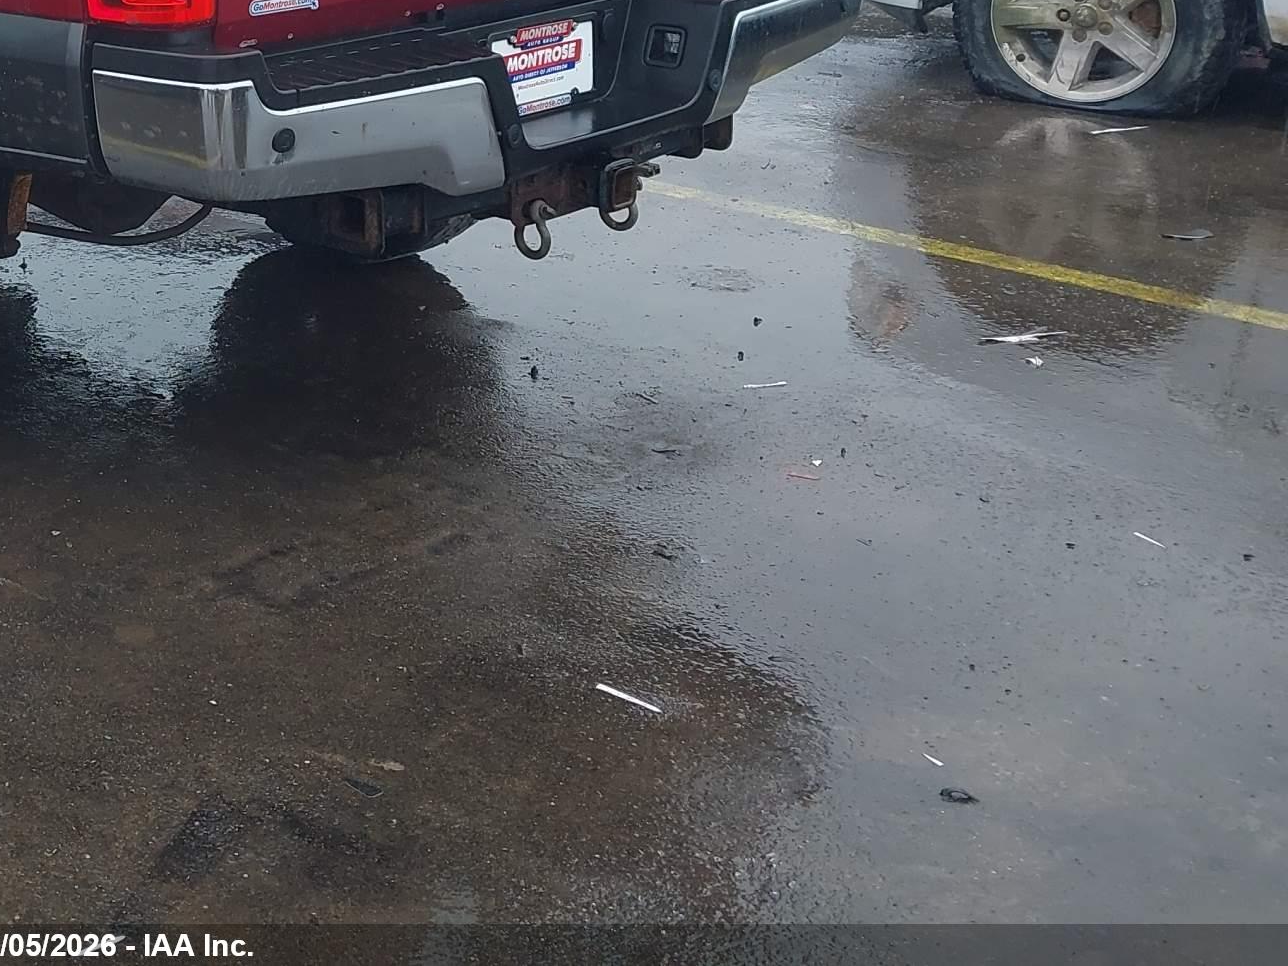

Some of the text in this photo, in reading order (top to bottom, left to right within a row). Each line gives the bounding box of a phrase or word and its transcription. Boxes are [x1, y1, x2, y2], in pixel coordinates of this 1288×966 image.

[520, 22, 568, 41] MONTROSE
[542, 36, 560, 44] GROUP
[507, 42, 575, 72] MONTROSE
[524, 70, 539, 79] DIRECT
[518, 96, 570, 114] GoMontrose.com
